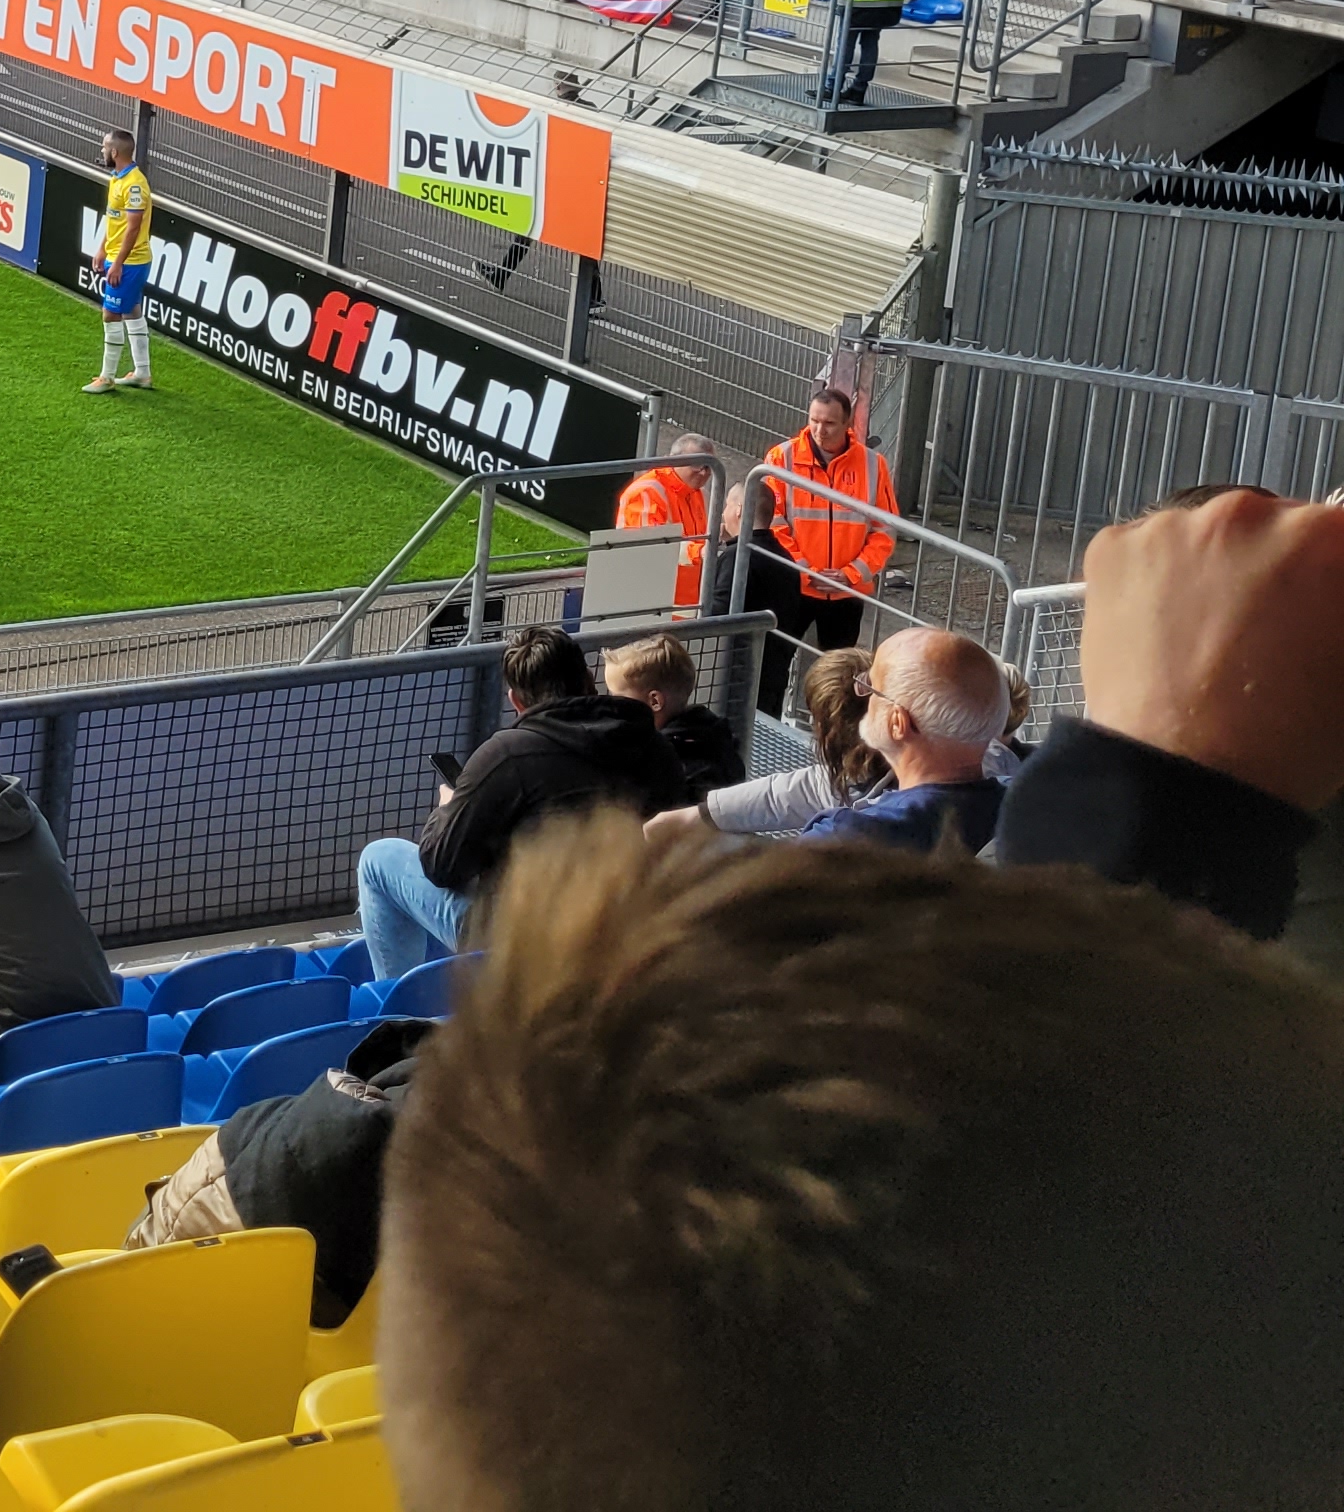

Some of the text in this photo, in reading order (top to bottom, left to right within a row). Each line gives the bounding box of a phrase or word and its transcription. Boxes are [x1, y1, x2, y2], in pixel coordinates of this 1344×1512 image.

[113, 6, 338, 148] SPORT
[403, 129, 532, 190] DE WIT
[420, 181, 509, 218] SCHIJNDEL
[78, 265, 182, 325] EXCIEVE
[185, 312, 296, 384] PERSONEN-
[301, 373, 330, 402] EN
